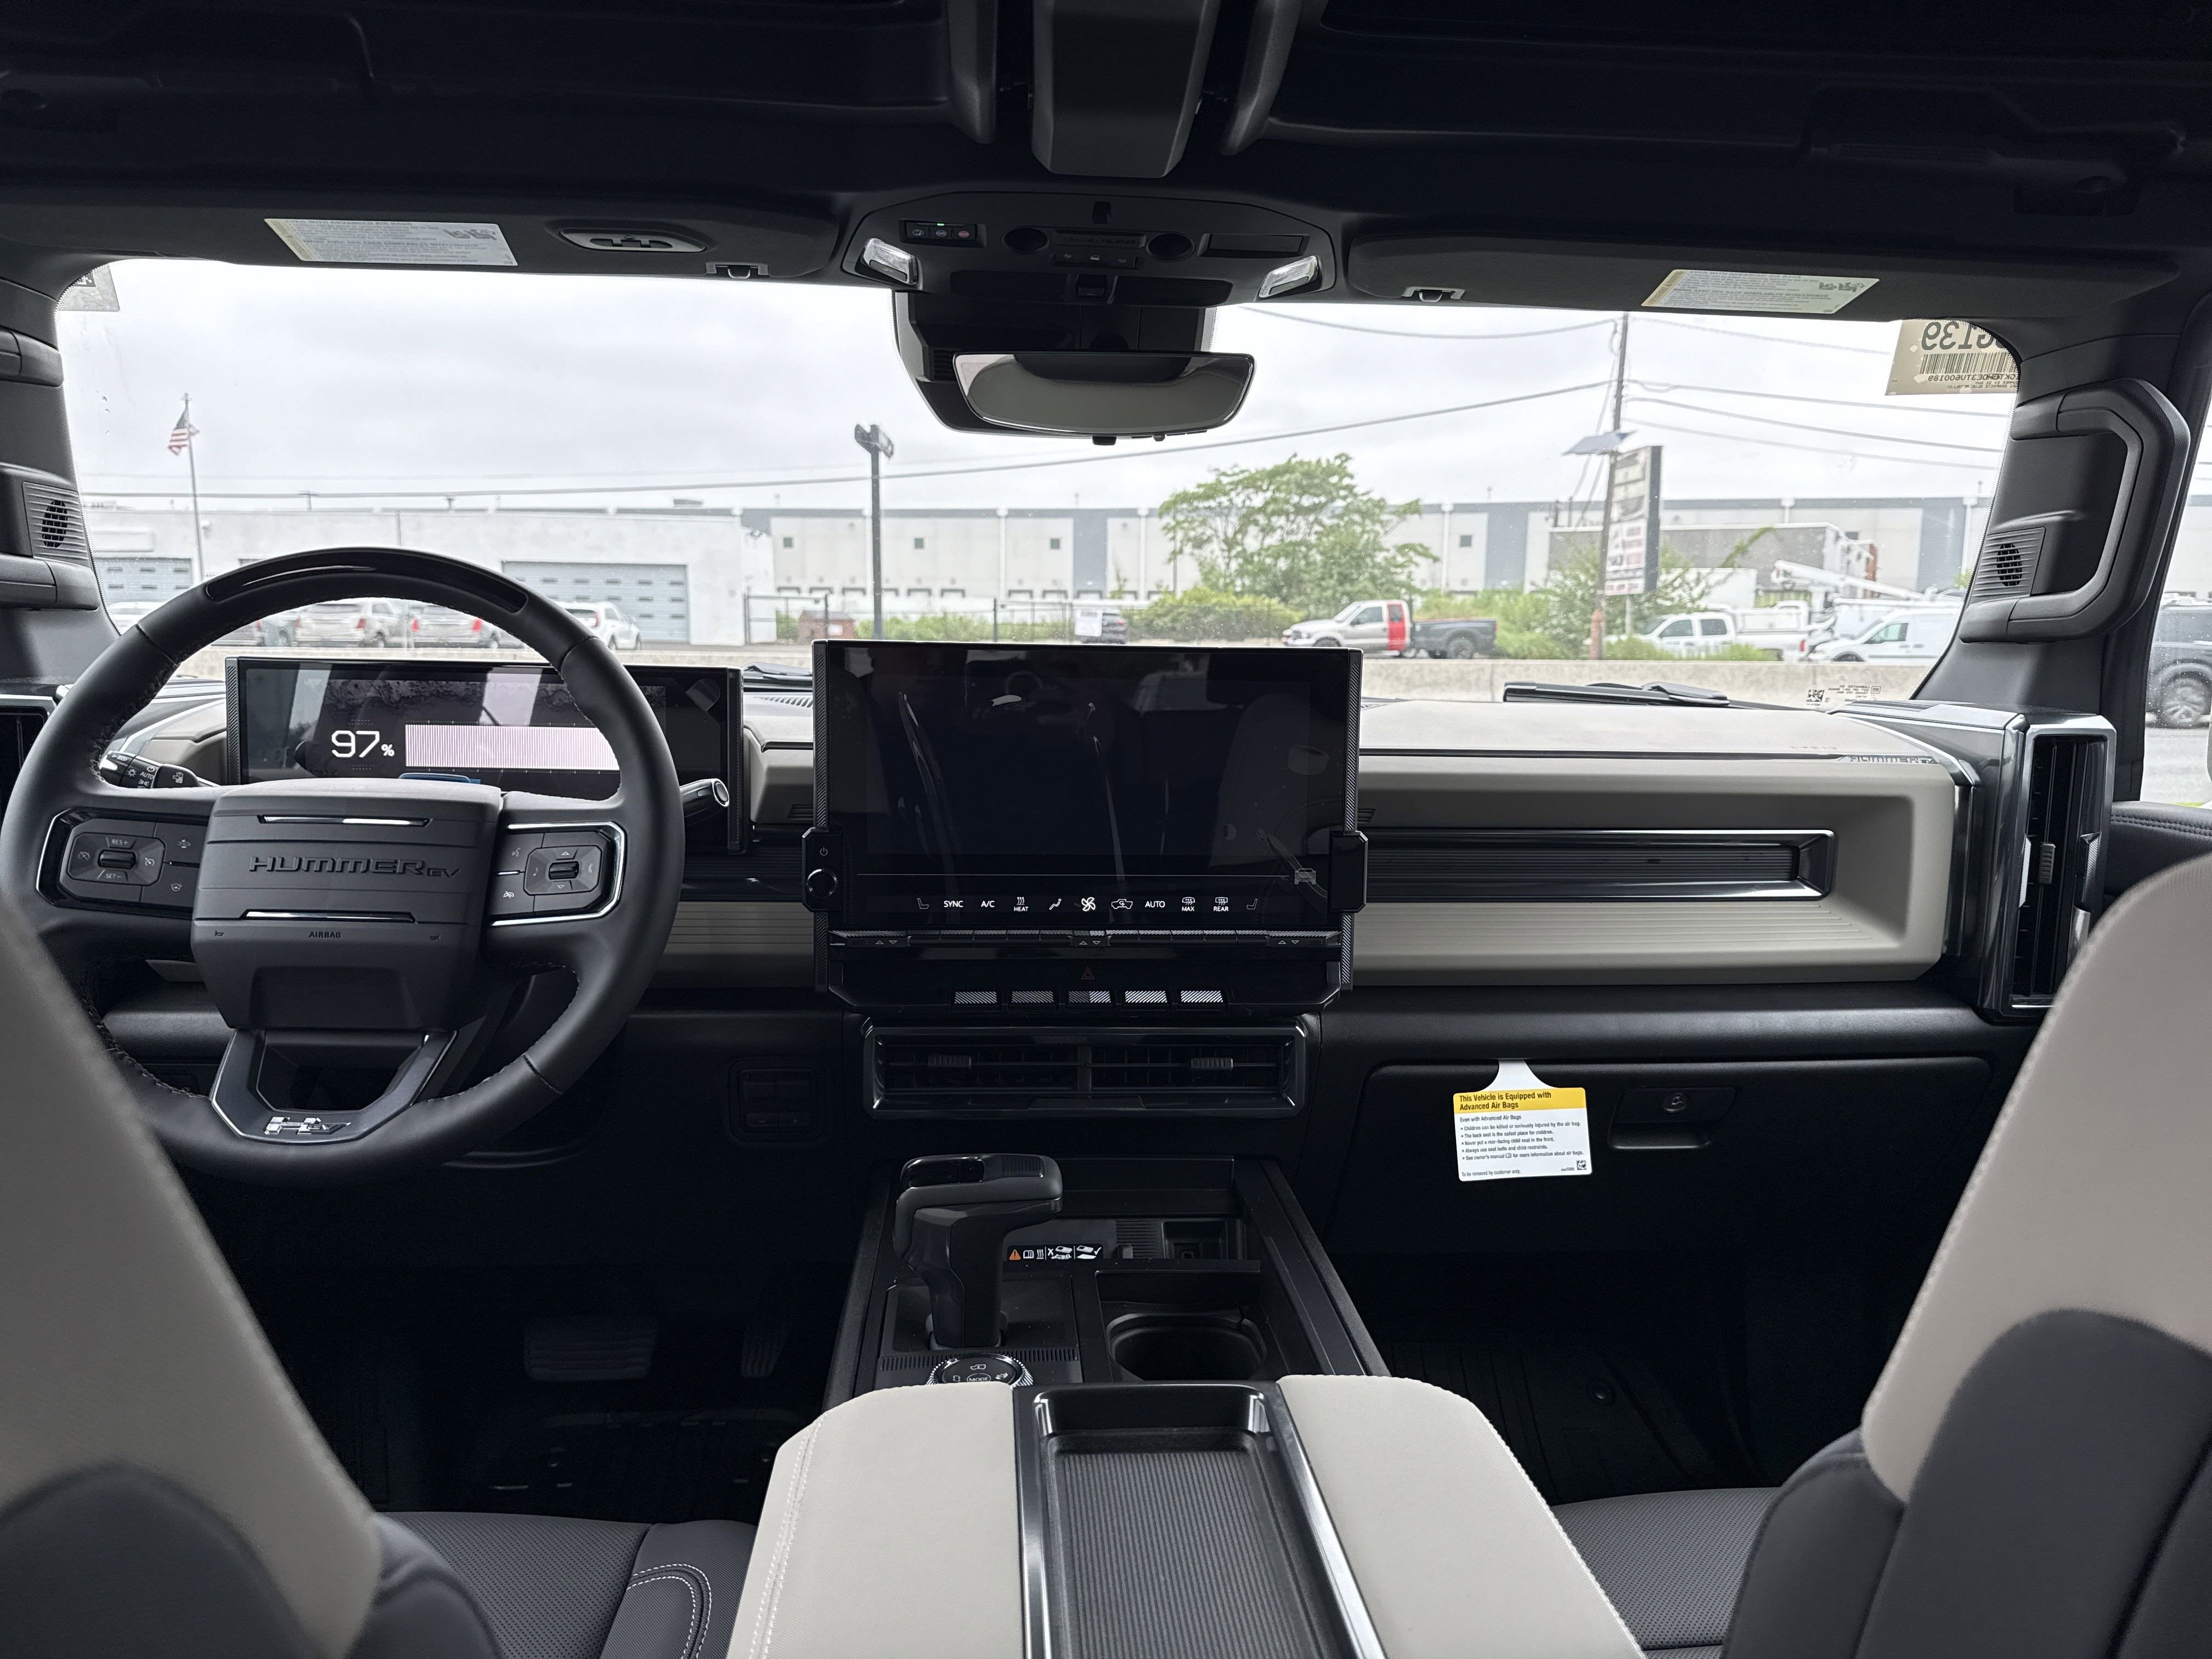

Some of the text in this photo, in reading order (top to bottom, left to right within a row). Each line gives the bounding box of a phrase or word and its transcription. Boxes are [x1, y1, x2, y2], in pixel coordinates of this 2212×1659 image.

[139, 771, 154, 780] AUTO
[250, 857, 461, 878] HUMMER EV
[1505, 1092, 1536, 1101] Equipped
[1460, 1102, 1489, 1111] Advanced
[1502, 1101, 1519, 1110] Bags
